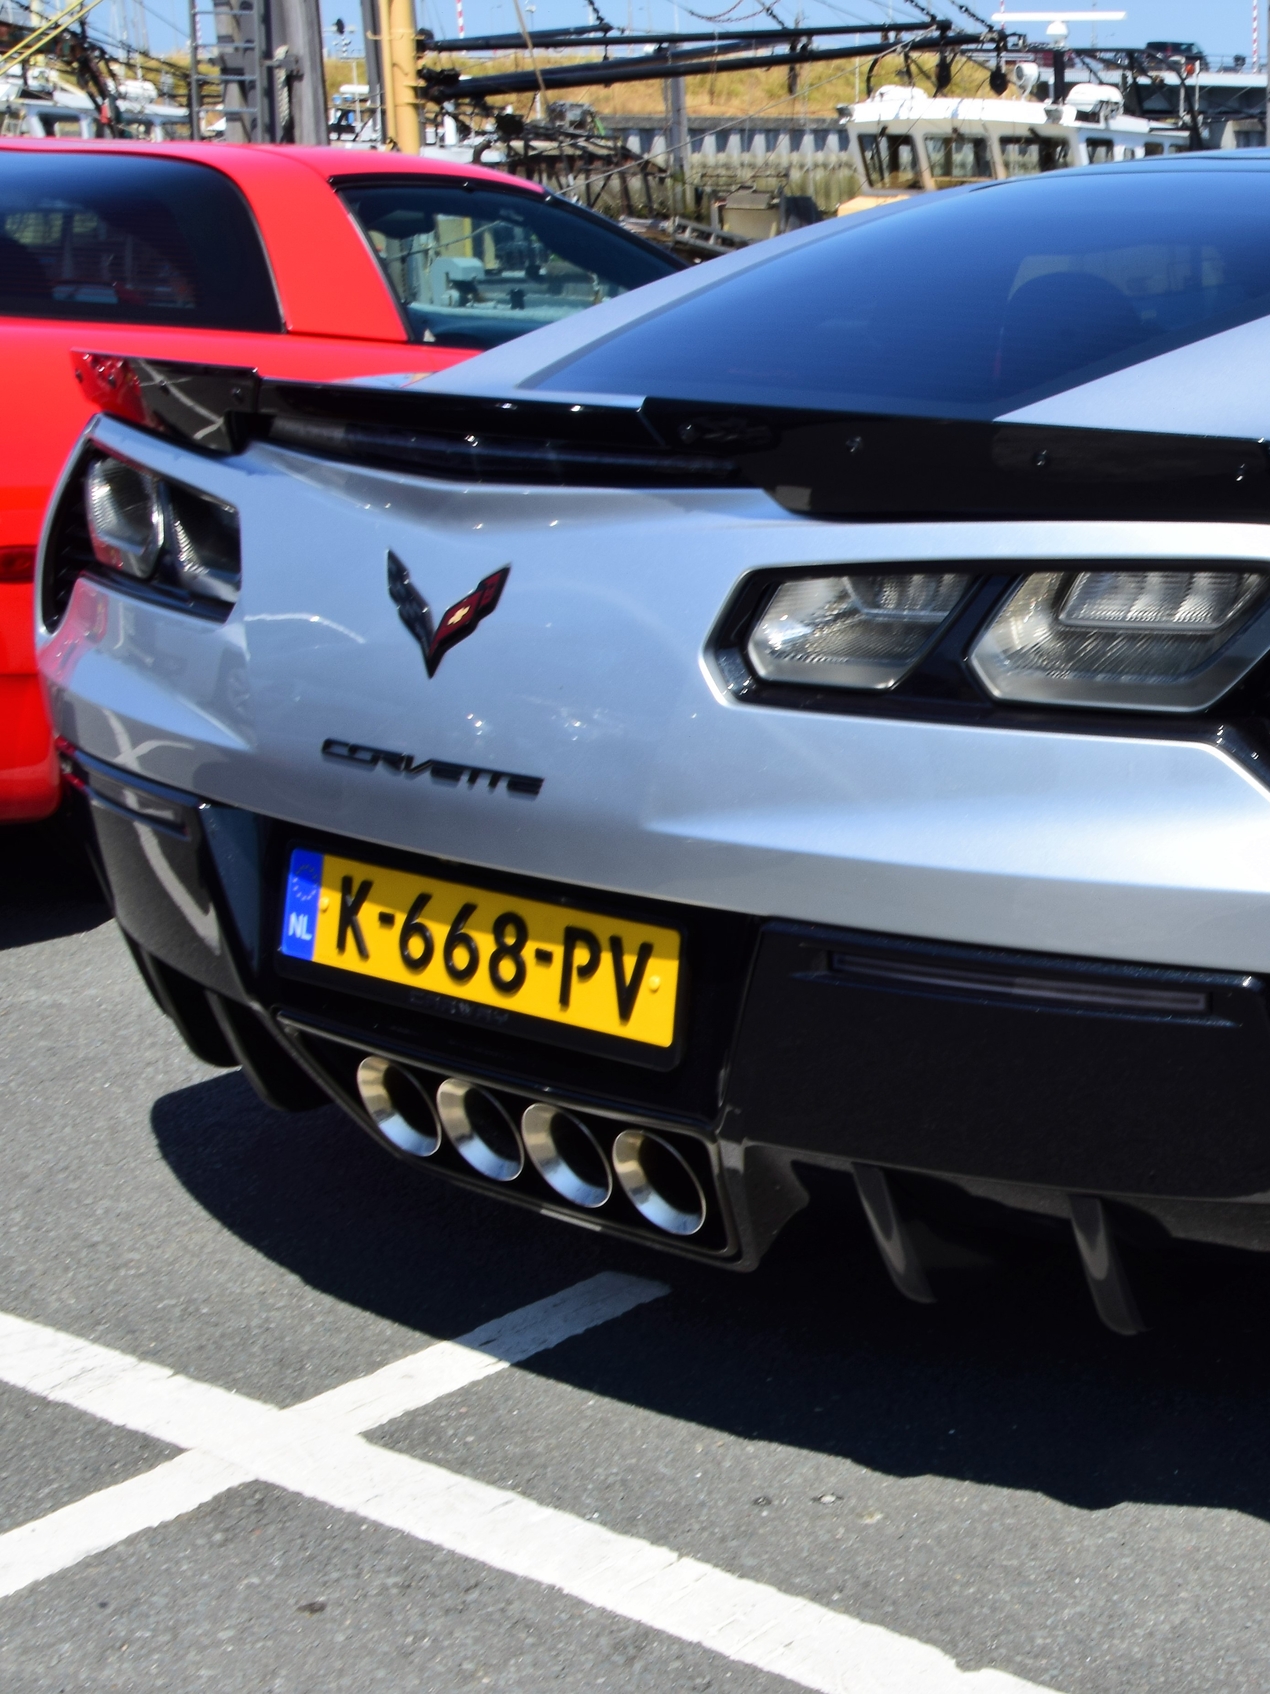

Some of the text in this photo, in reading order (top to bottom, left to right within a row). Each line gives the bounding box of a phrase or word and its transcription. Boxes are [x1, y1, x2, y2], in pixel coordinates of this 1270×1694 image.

[321, 738, 545, 796] CORVETTE
[288, 912, 312, 941] NL
[336, 874, 654, 1026] K-668-PV
